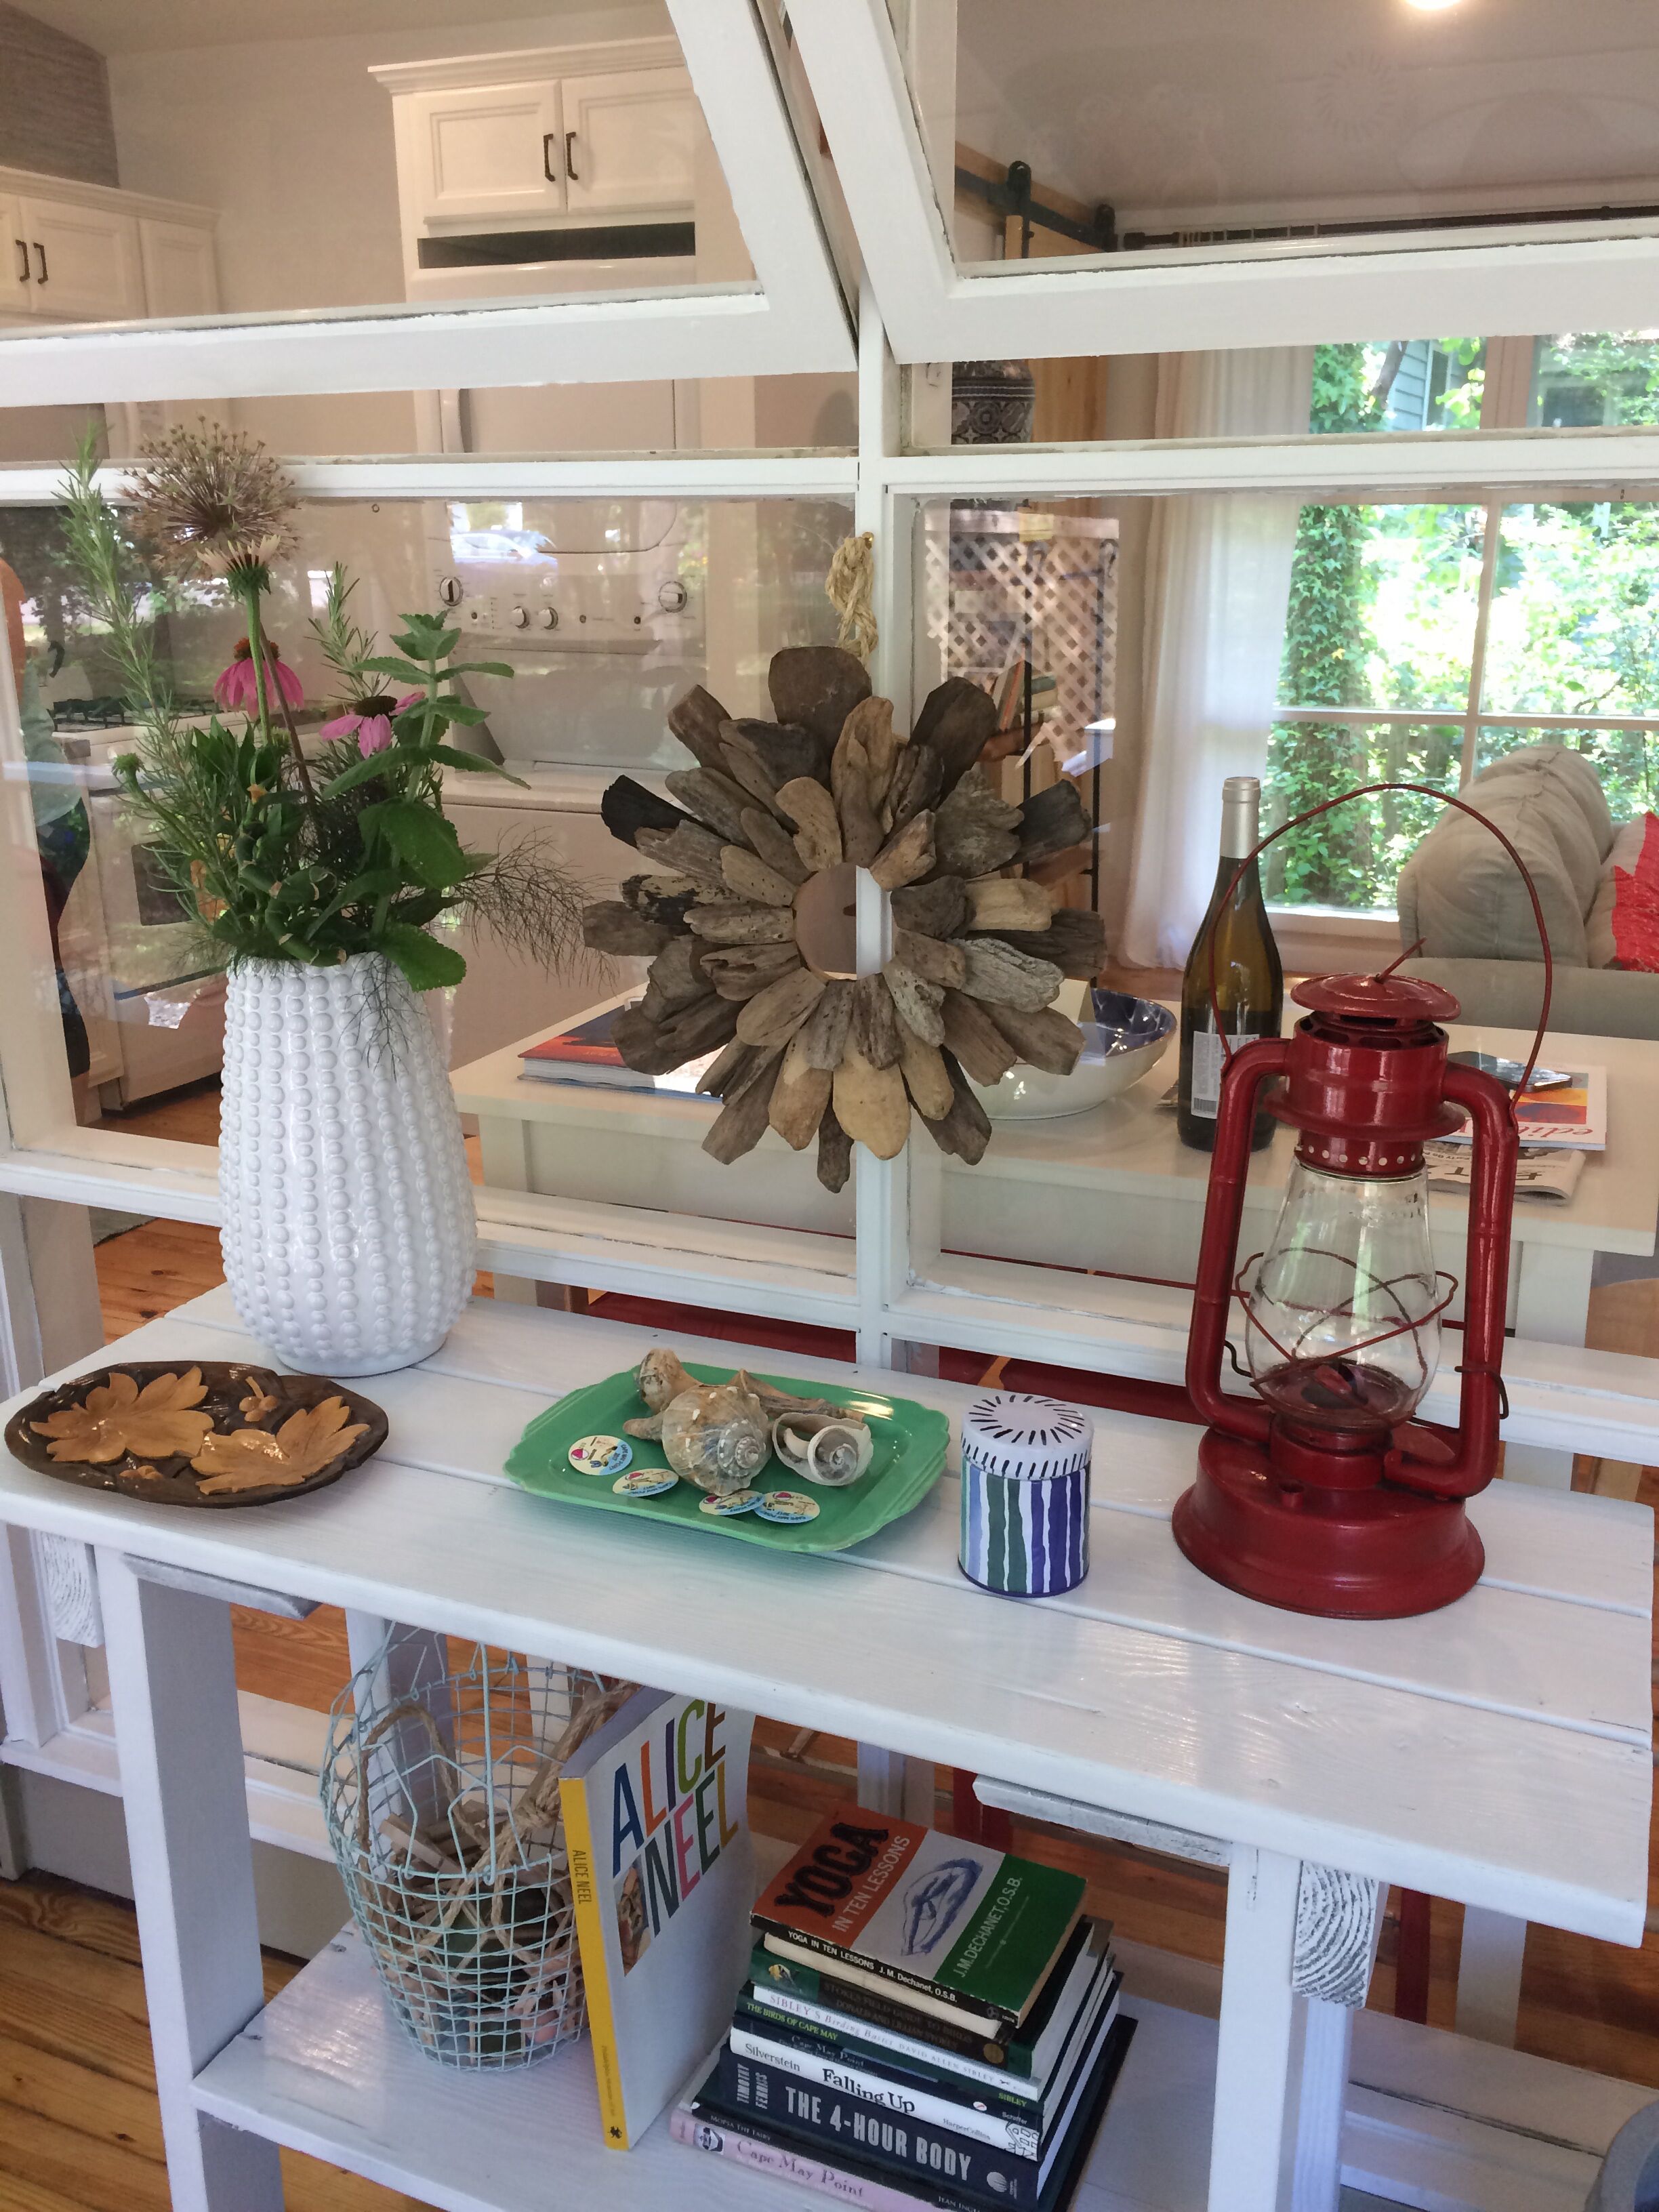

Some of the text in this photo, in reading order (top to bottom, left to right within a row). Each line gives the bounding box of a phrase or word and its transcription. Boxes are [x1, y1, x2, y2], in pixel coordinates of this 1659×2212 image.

[613, 1699, 726, 1879] ALICE
[573, 1849, 592, 1904] ALICE NEEL
[644, 1760, 739, 1938] NEEL
[774, 1822, 889, 1918] YOGA
[832, 1835, 910, 1932] IN TEN LESSONS
[788, 1931, 808, 1944] YOGA
[811, 1940, 819, 1949] IN
[823, 1943, 838, 1956] TEN
[840, 1950, 874, 1970] LESSONS
[897, 1972, 933, 1994] Dechanet,
[935, 1988, 958, 2003] O.S.B.
[747, 2002, 838, 2041] THE BIRDS OF CAPE MAY
[825, 2015, 859, 2036] Birding
[745, 2043, 800, 2072] Silverstein
[822, 2068, 884, 2107] Falling
[888, 2091, 916, 2114] Up
[943, 2118, 991, 2141] HarperCollins
[785, 2086, 971, 2181] THE 4-HOUR BODY
[737, 2141, 863, 2197] Cape May Point
